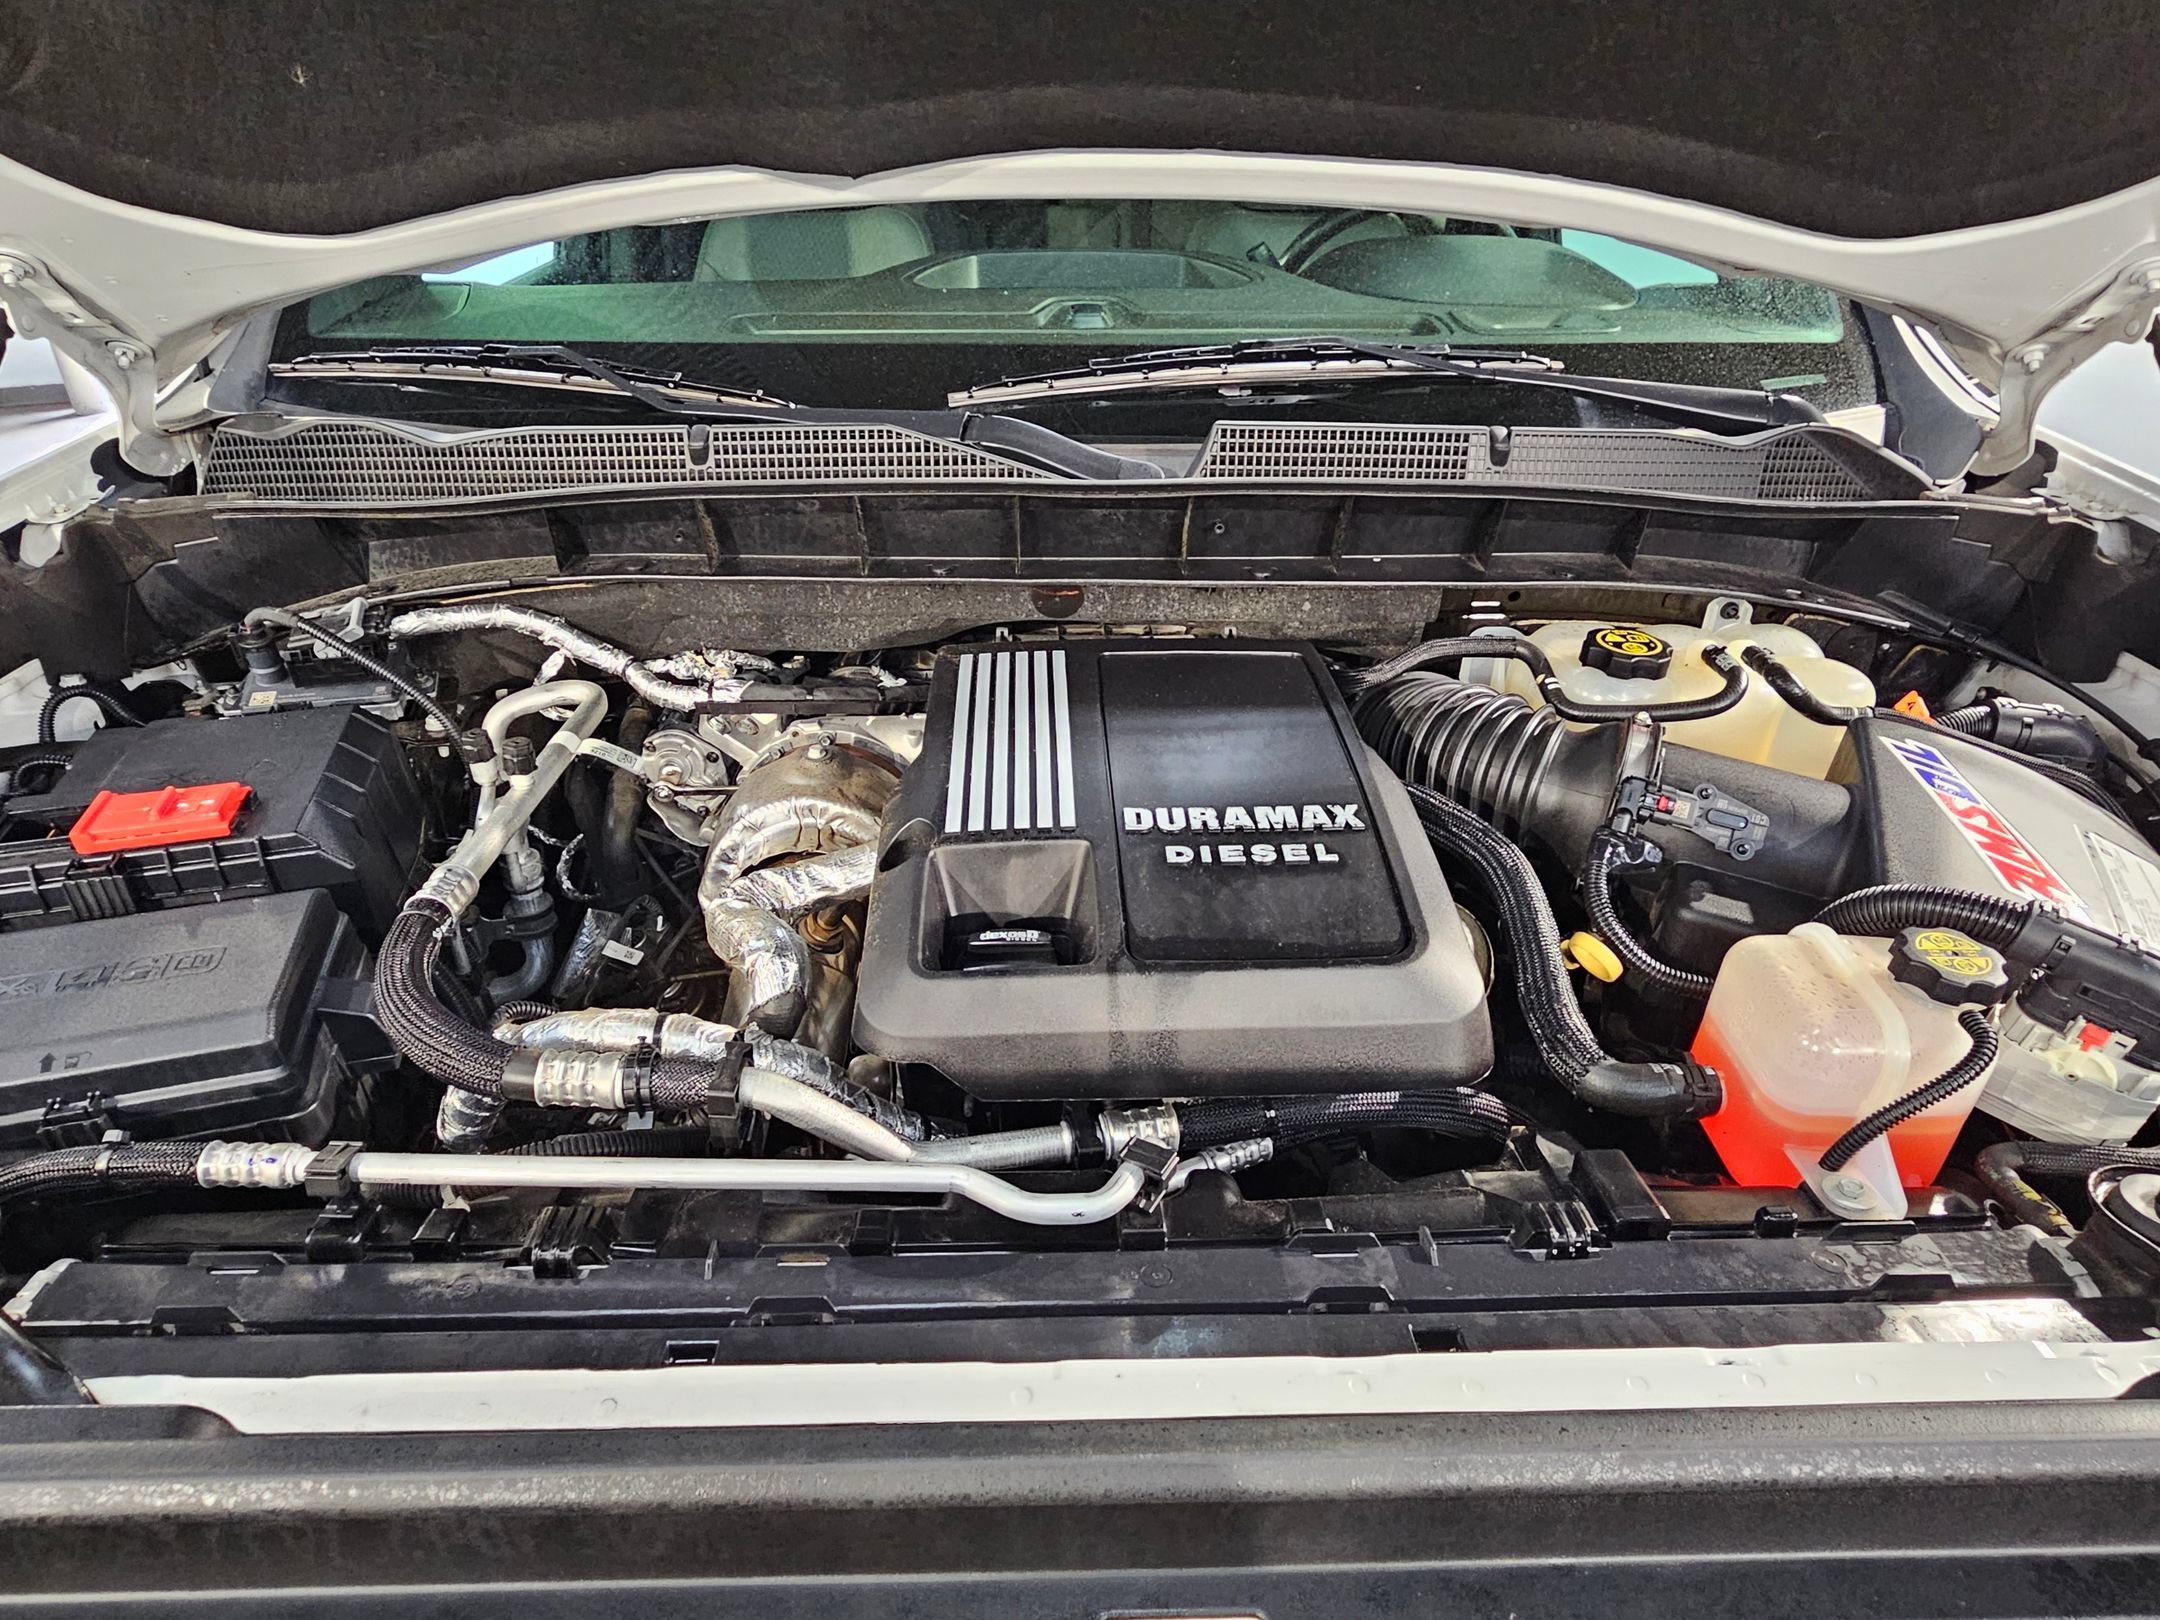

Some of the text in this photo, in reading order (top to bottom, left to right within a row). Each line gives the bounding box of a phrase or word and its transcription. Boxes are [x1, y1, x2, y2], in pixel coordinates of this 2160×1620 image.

[1123, 804, 1366, 833] DURAMAX
[1888, 741, 2076, 907] AMSOIL
[1165, 844, 1340, 864] DIESEL
